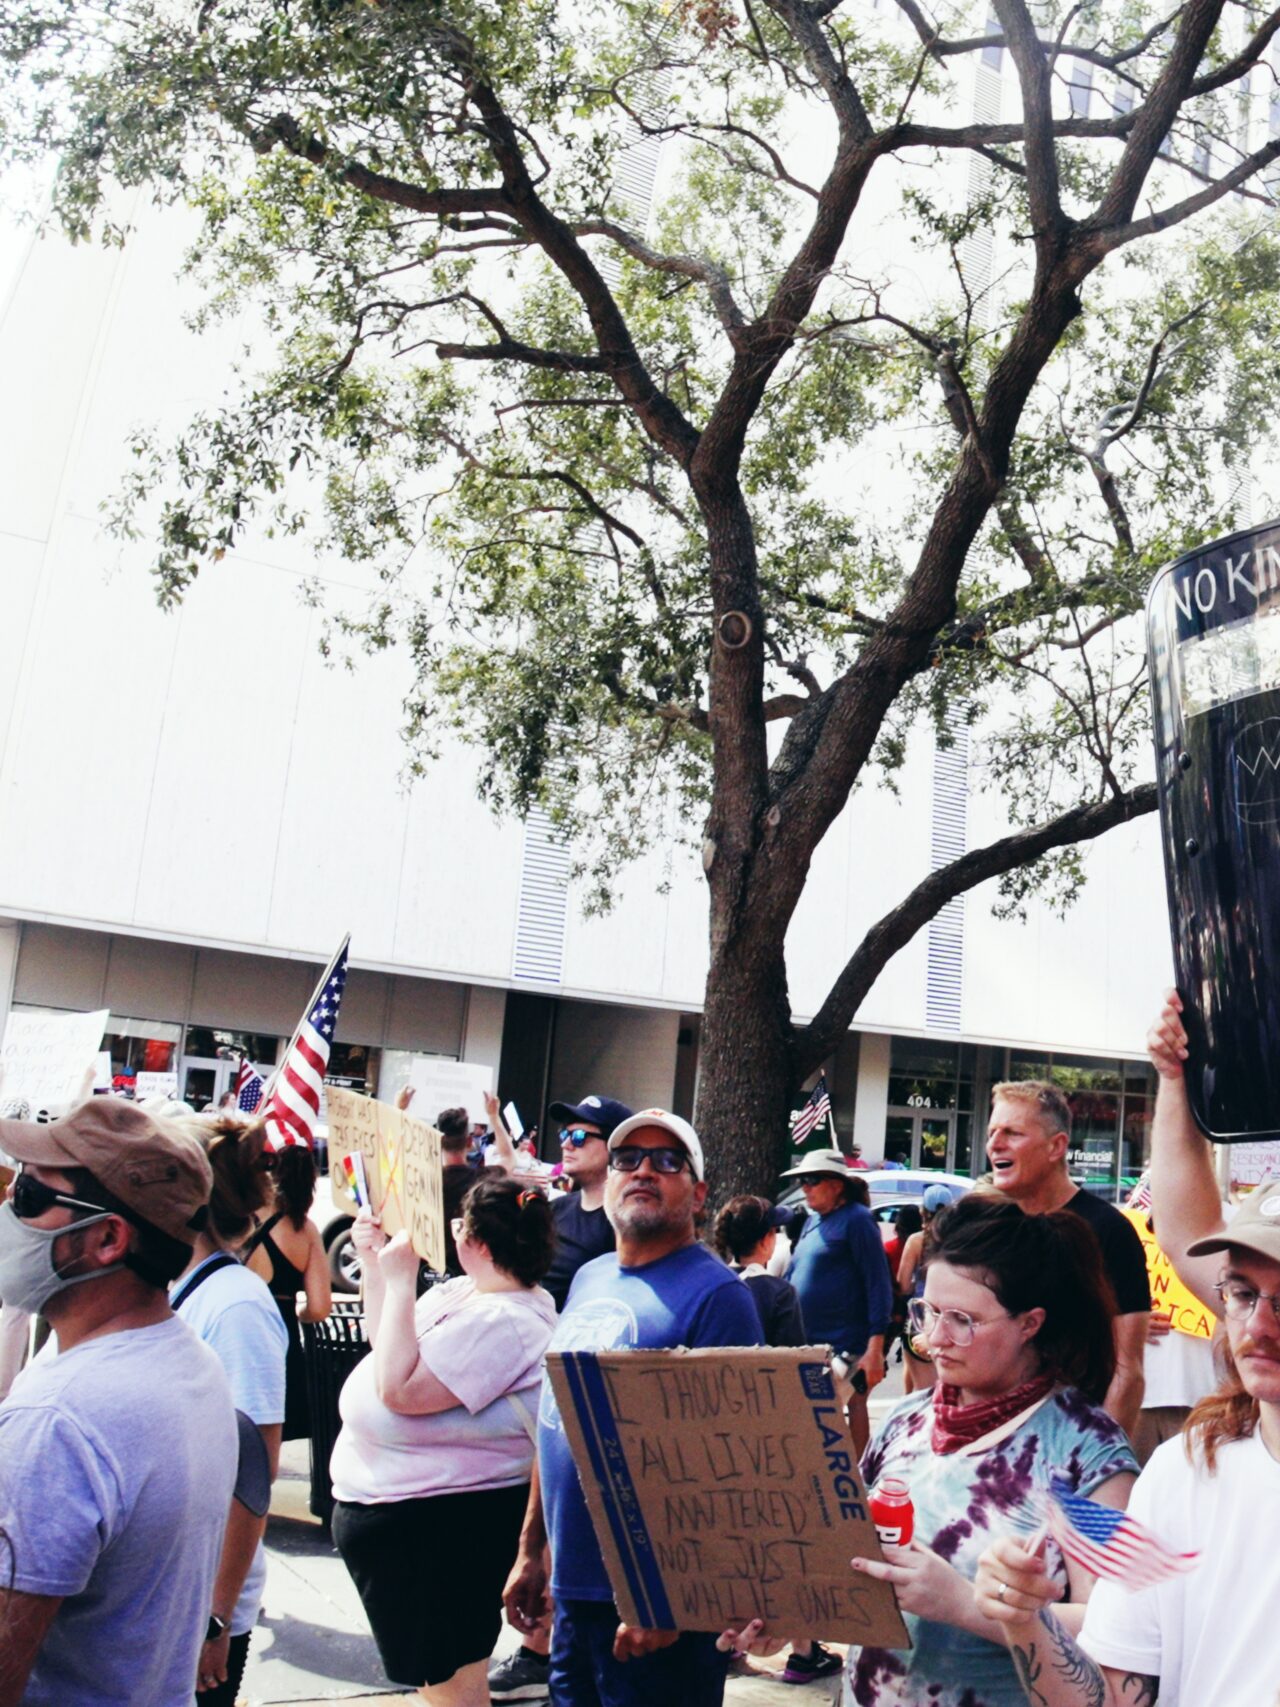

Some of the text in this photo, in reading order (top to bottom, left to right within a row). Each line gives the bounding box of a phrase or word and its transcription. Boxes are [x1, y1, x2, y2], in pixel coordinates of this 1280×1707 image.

[1168, 568, 1216, 621] NO
[907, 1095, 931, 1109] 404
[1074, 1149, 1113, 1162] financial
[599, 1366, 640, 1426] I
[640, 1363, 779, 1421] THOUGHT
[702, 1432, 799, 1481] LIVES
[812, 1406, 867, 1521] LARGE
[658, 1535, 814, 1583] NOT JUST
[679, 1583, 872, 1627] WHITE ONES
